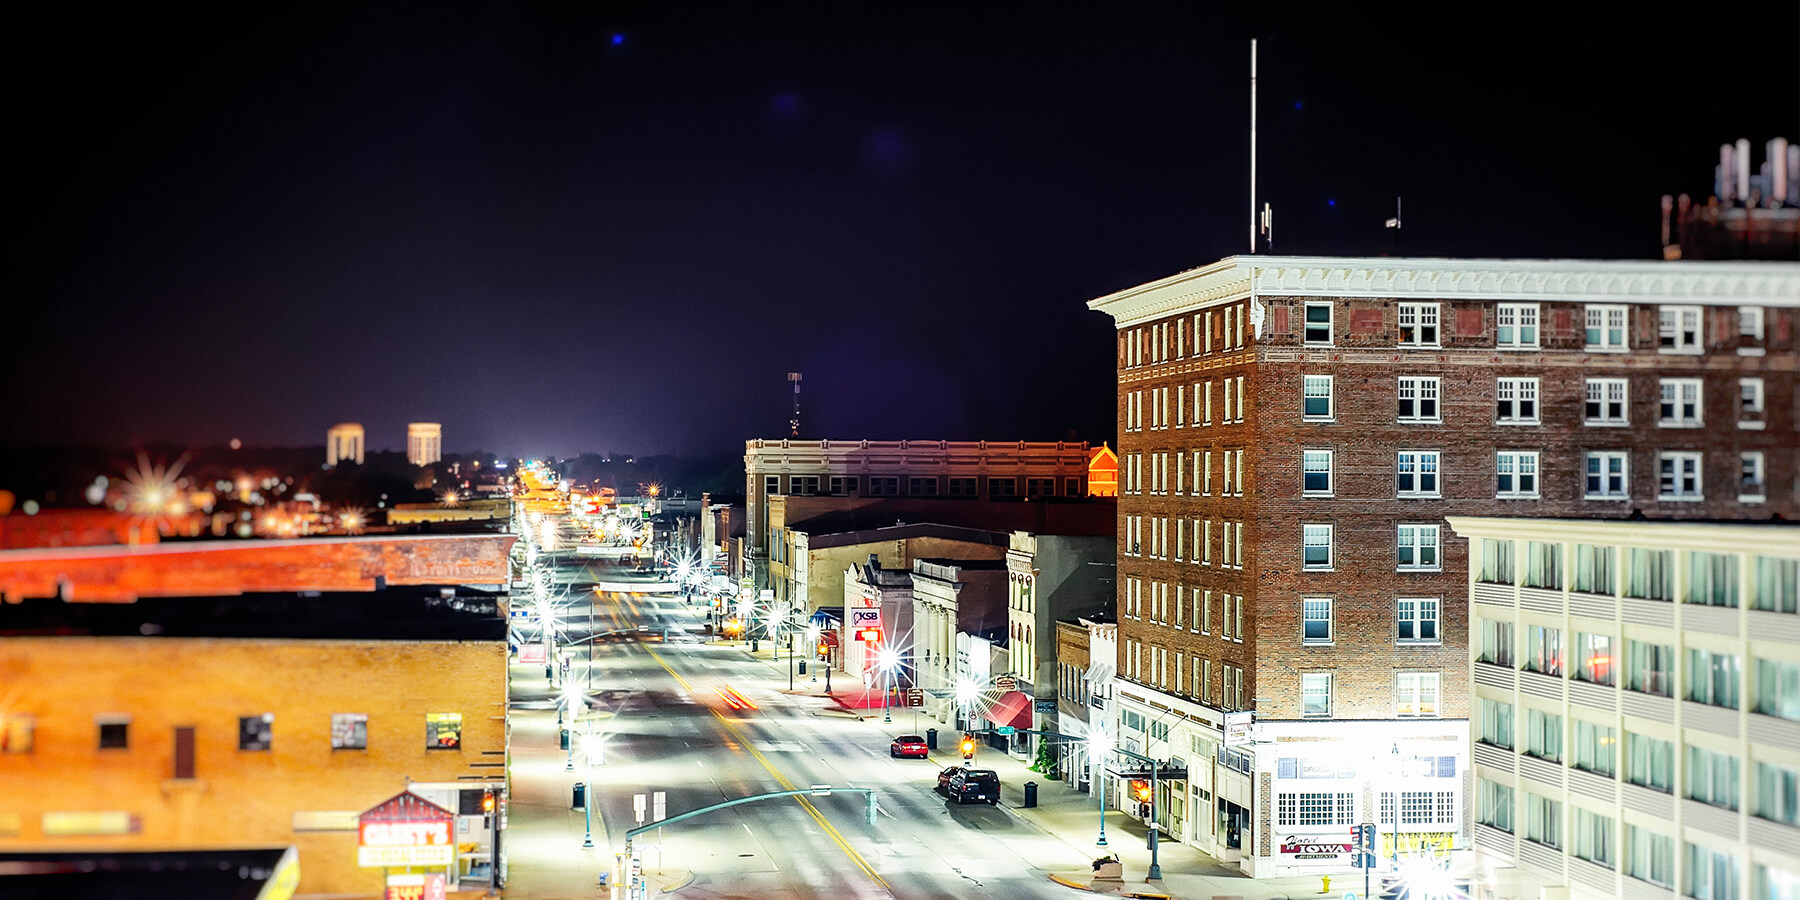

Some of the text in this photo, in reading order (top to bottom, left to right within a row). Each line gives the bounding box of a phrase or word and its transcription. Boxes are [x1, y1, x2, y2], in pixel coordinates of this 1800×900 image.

[859, 612, 878, 620] KSB
[1285, 835, 1319, 850] Hotel
[1300, 845, 1348, 853] IOWA
